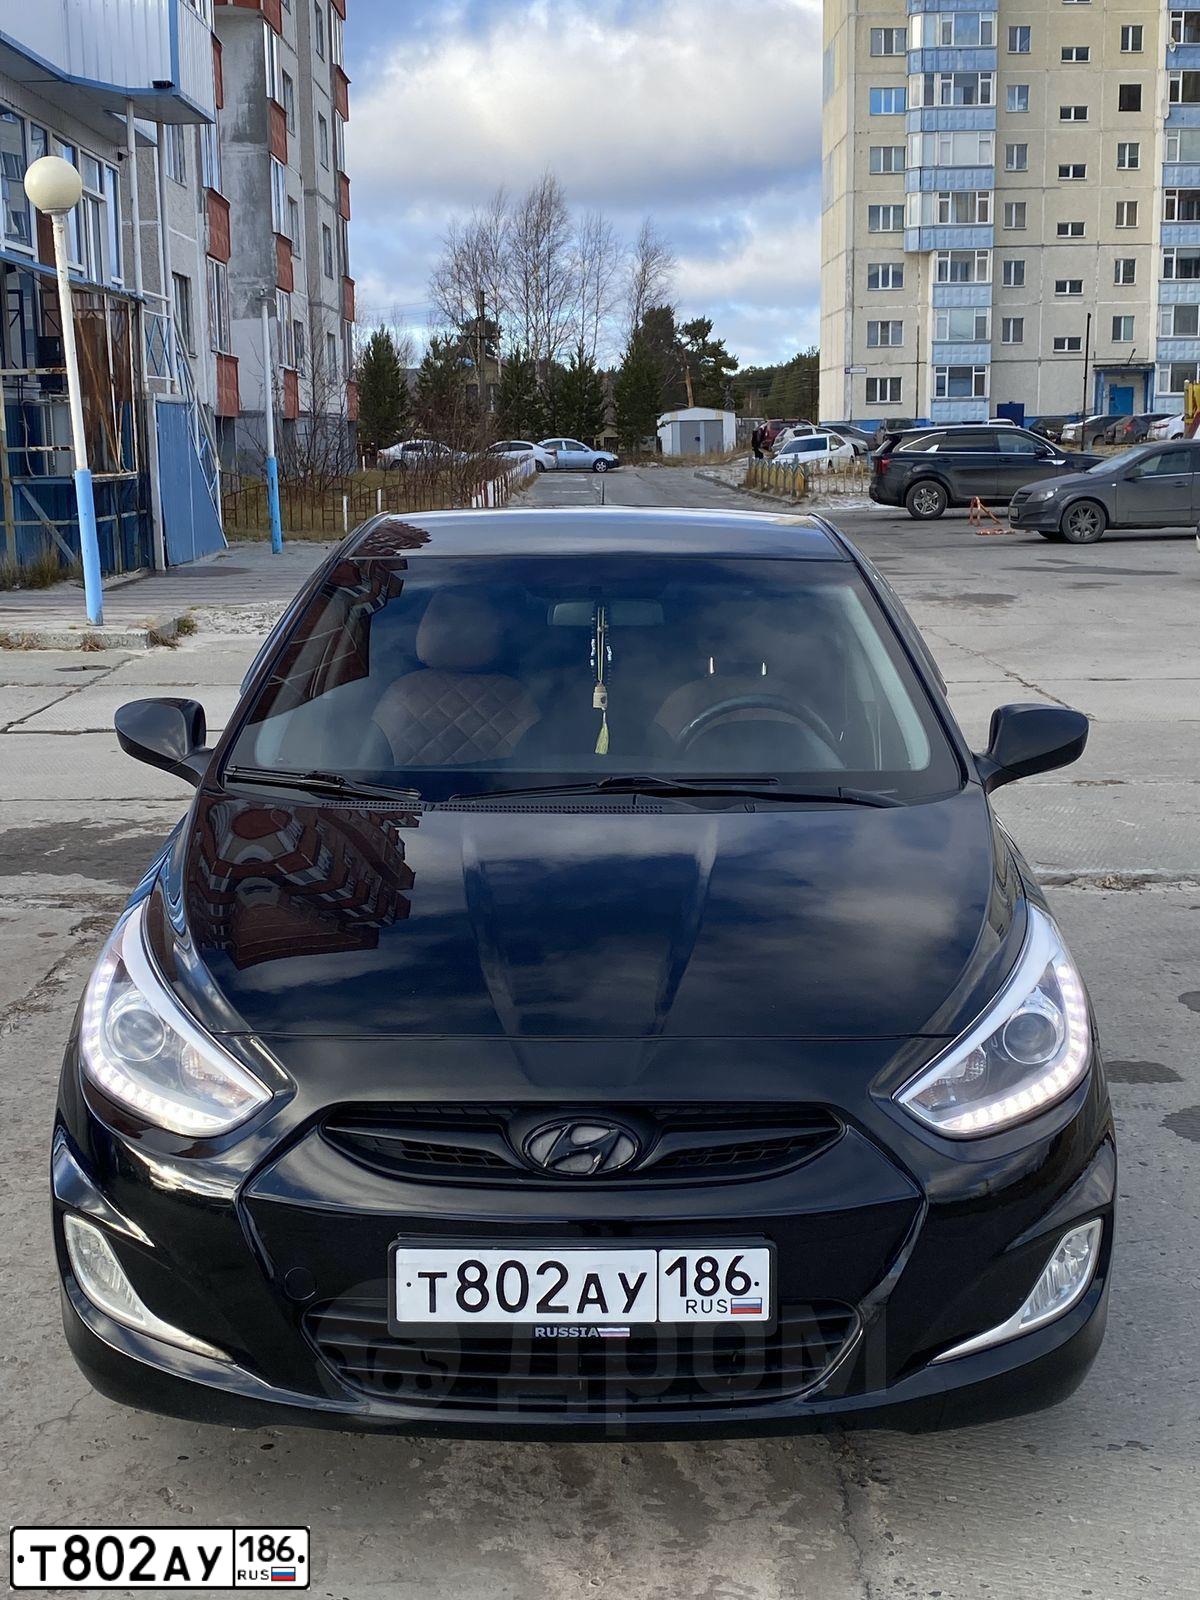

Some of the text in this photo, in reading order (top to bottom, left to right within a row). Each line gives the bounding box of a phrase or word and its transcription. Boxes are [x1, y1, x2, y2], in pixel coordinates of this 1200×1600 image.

[418, 1260, 647, 1313] Т802АУ
[665, 1256, 752, 1298] 186
[686, 1299, 728, 1314] RUS
[535, 1327, 599, 1338] RUSSIA
